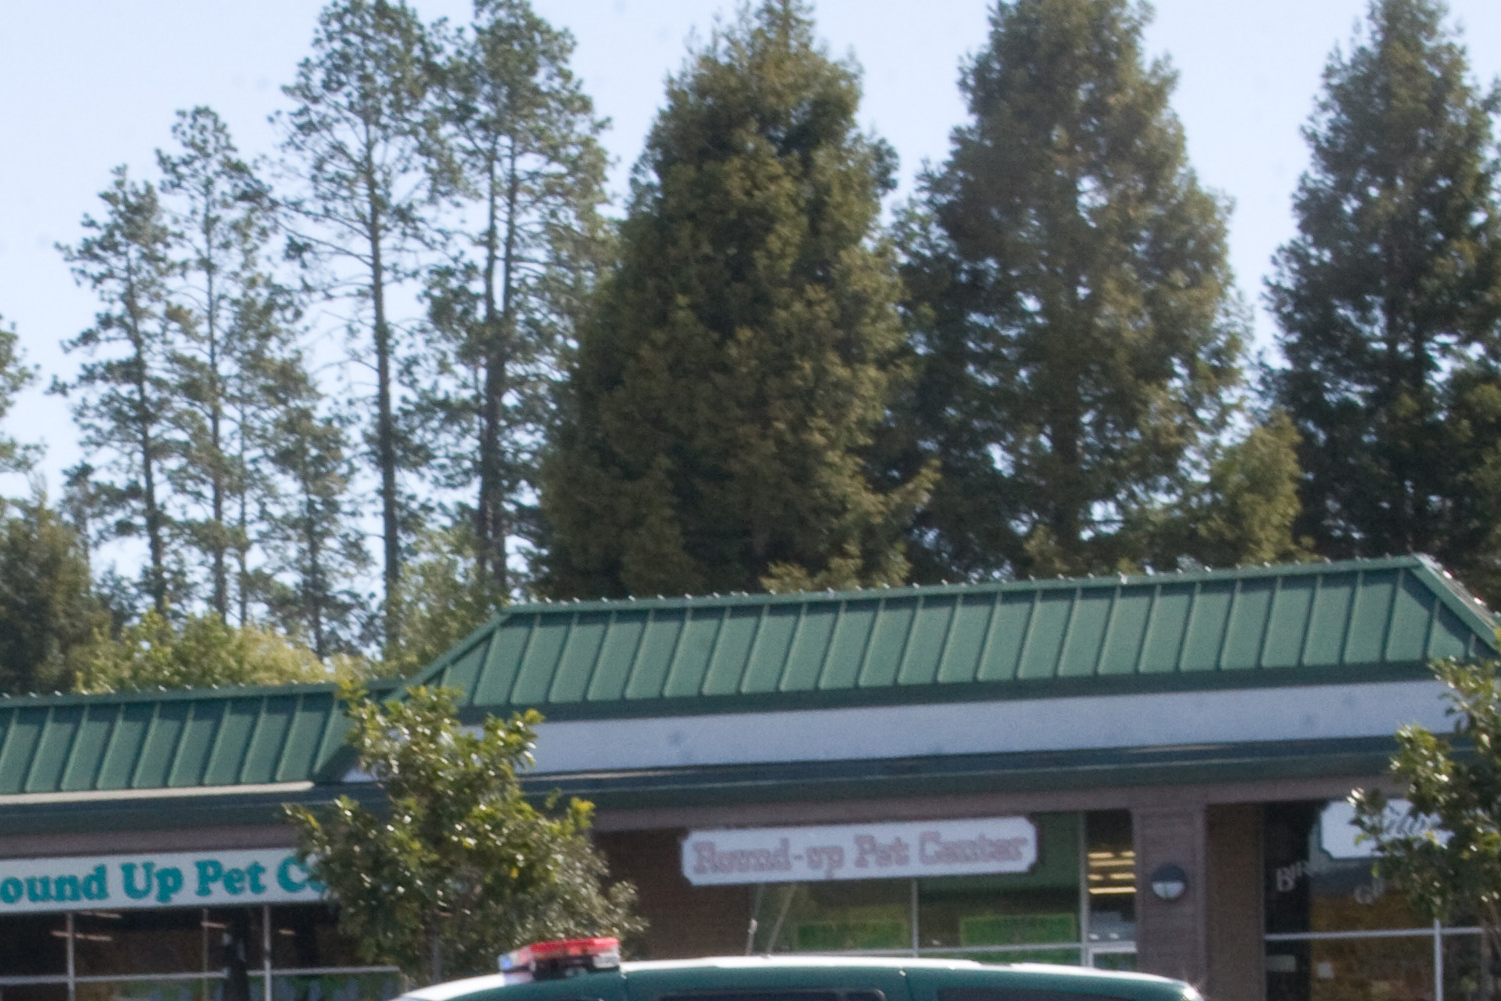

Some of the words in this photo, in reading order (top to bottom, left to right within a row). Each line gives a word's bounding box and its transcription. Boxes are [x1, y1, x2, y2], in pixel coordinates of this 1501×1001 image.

[854, 834, 910, 869] Pet
[120, 861, 184, 903] Up
[195, 858, 266, 897] Pet
